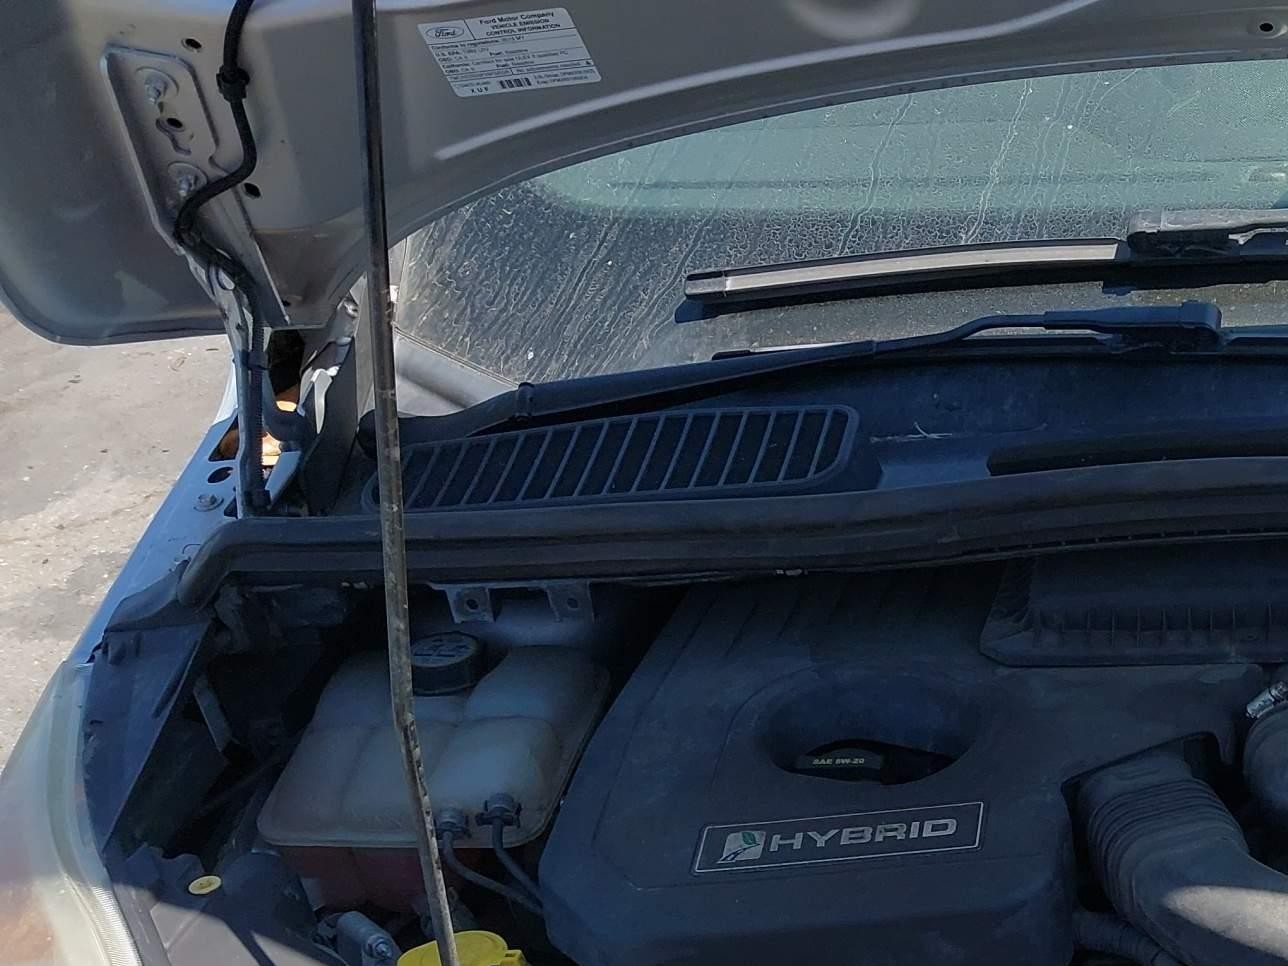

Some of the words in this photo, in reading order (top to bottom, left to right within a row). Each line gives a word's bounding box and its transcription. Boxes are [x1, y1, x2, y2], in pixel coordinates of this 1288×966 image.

[520, 11, 554, 20] Company
[519, 18, 550, 26] EMISSION
[517, 23, 561, 32] INFORMATION
[435, 28, 456, 37] Ford
[768, 818, 958, 852] HYBRID
